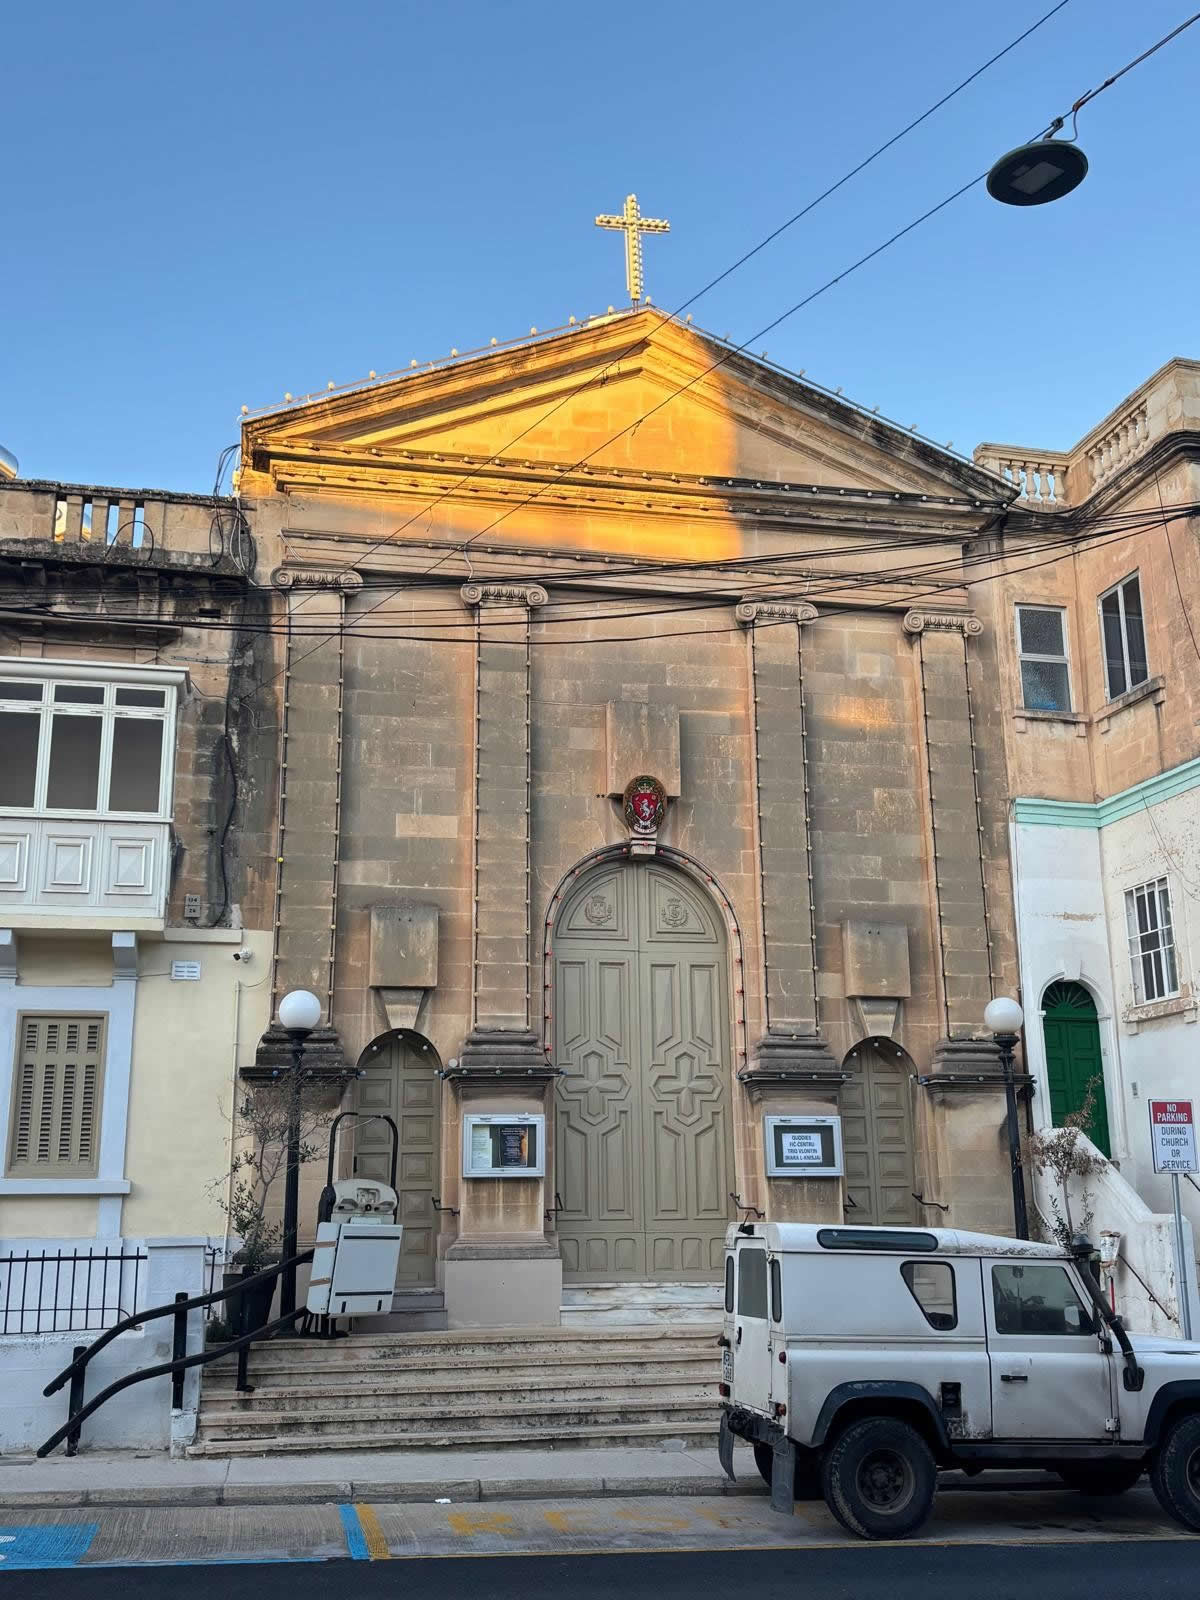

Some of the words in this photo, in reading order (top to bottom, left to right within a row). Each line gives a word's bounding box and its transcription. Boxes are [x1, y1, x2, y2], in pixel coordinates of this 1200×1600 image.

[1167, 1103, 1177, 1112] NO
[1157, 1113, 1188, 1122] PARKING
[1161, 1126, 1187, 1136] DURING
[1161, 1137, 1189, 1146] CHURCH
[1171, 1149, 1181, 1157] OR
[1162, 1160, 1191, 1169] SERVICE
